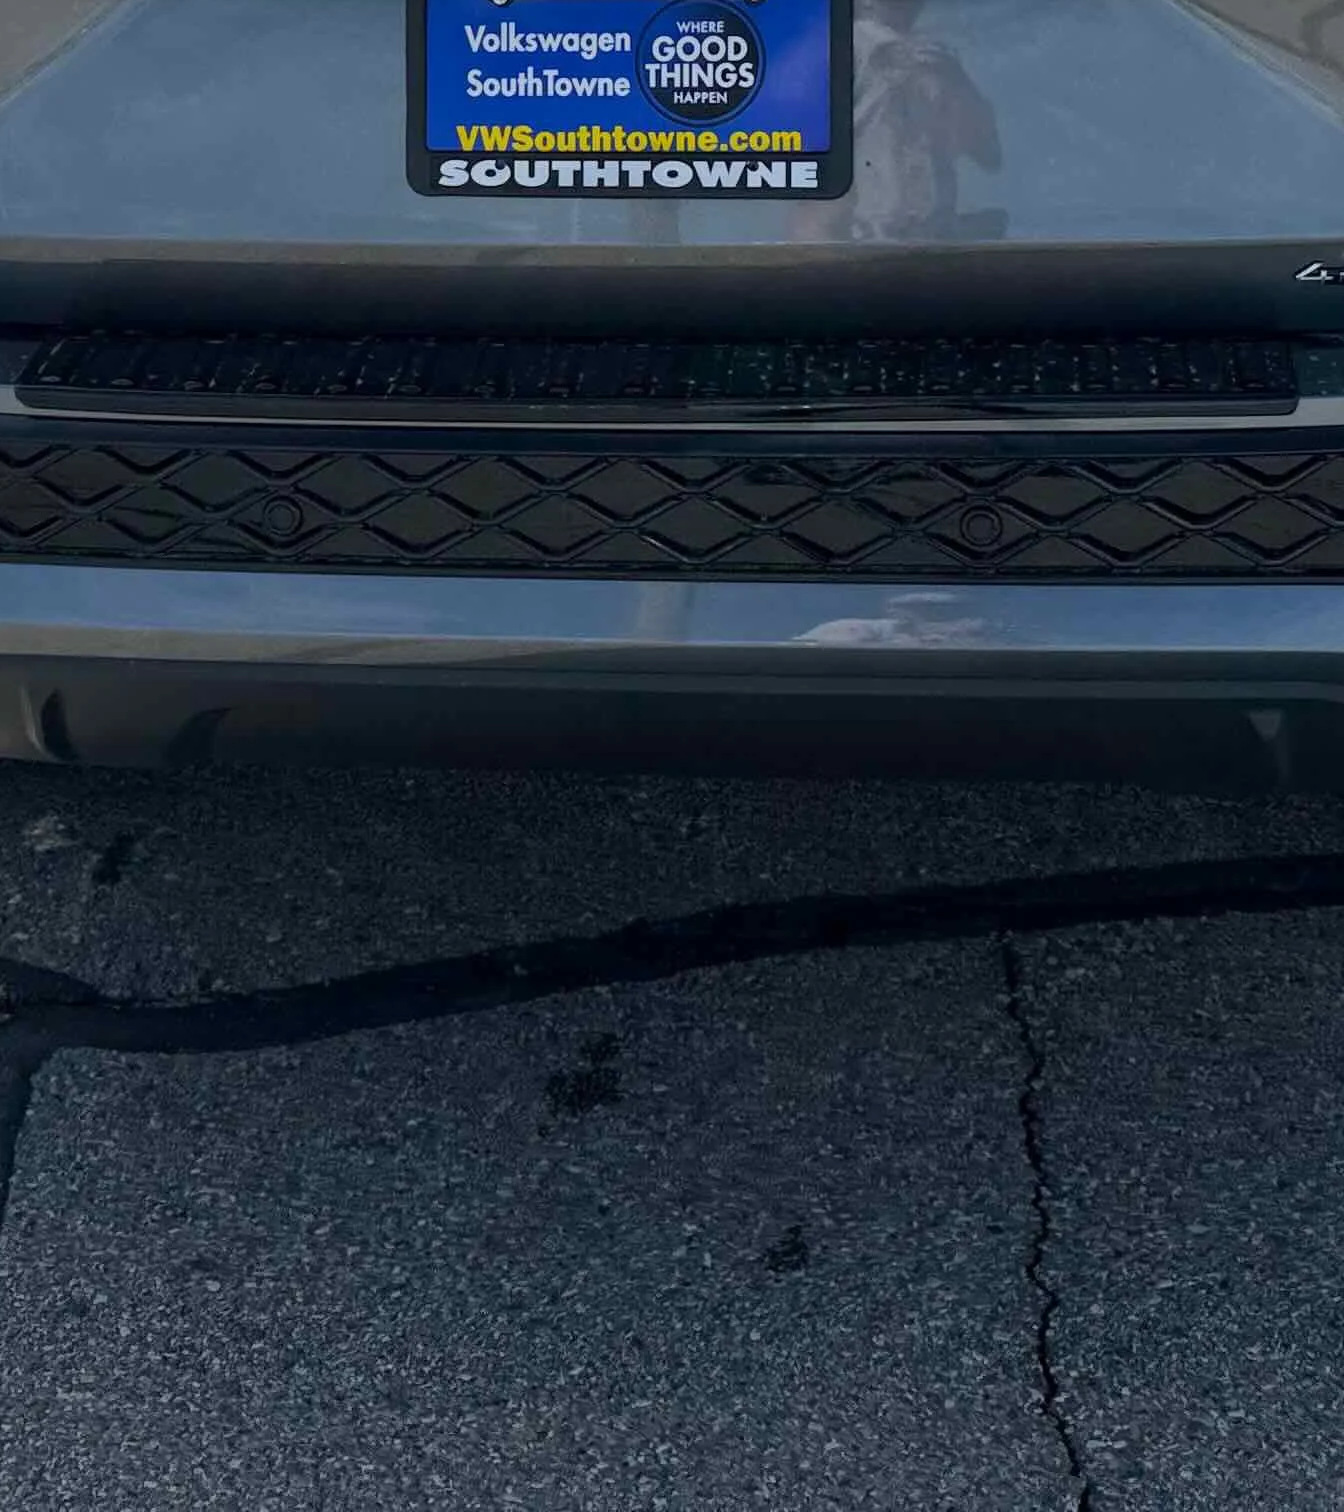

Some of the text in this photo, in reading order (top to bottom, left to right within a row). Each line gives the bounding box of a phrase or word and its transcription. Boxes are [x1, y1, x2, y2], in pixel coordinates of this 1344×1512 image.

[464, 22, 632, 60] Volkswagen
[676, 21, 725, 33] WHERE
[652, 35, 748, 63] GOOD
[466, 66, 631, 98] SouthTowne
[645, 62, 755, 89] THINGS
[673, 91, 728, 105] HAPPEN
[456, 124, 802, 153] VWSouthtowne.com
[437, 159, 819, 189] SOUTHTOWNE
